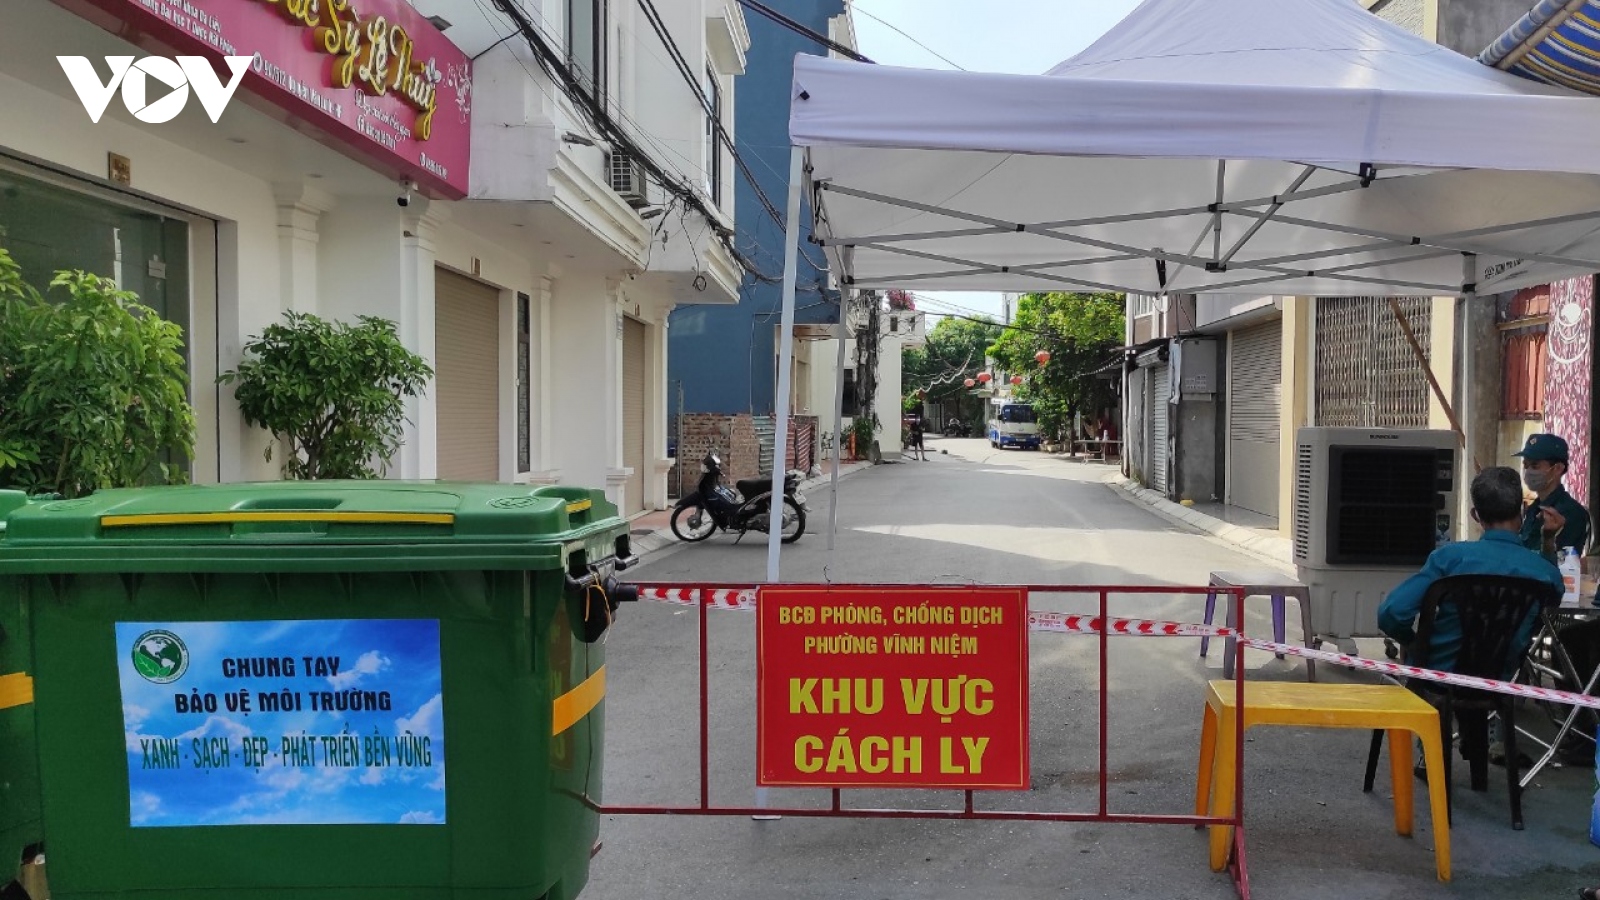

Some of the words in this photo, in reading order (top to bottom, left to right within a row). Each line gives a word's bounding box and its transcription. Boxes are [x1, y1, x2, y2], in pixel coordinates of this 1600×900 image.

[779, 606, 816, 624] BCĐ
[893, 600, 955, 624] CHỐNG
[960, 606, 1003, 628] DỊCH
[804, 632, 878, 654] PHƯỜNG
[883, 633, 925, 654] VĨNH
[930, 633, 978, 658] NIỆM
[222, 657, 296, 678] CHUNG
[303, 656, 340, 677] TAY
[175, 687, 217, 713] BẢO
[225, 688, 251, 716] VỆ
[259, 688, 300, 712] MÔI
[309, 688, 391, 711] TRƯỜNG
[789, 678, 884, 714] KHU
[900, 674, 994, 723] VỰC
[140, 738, 180, 769] XANH
[193, 737, 230, 774] SẠCH
[243, 736, 268, 774] ĐẸP
[282, 729, 317, 767] PHÁT
[320, 722, 359, 767] TRIỂN
[365, 725, 391, 767] BỀN
[395, 730, 432, 767] VỮNG
[794, 728, 922, 774] CÁCH
[940, 737, 990, 774] LY
